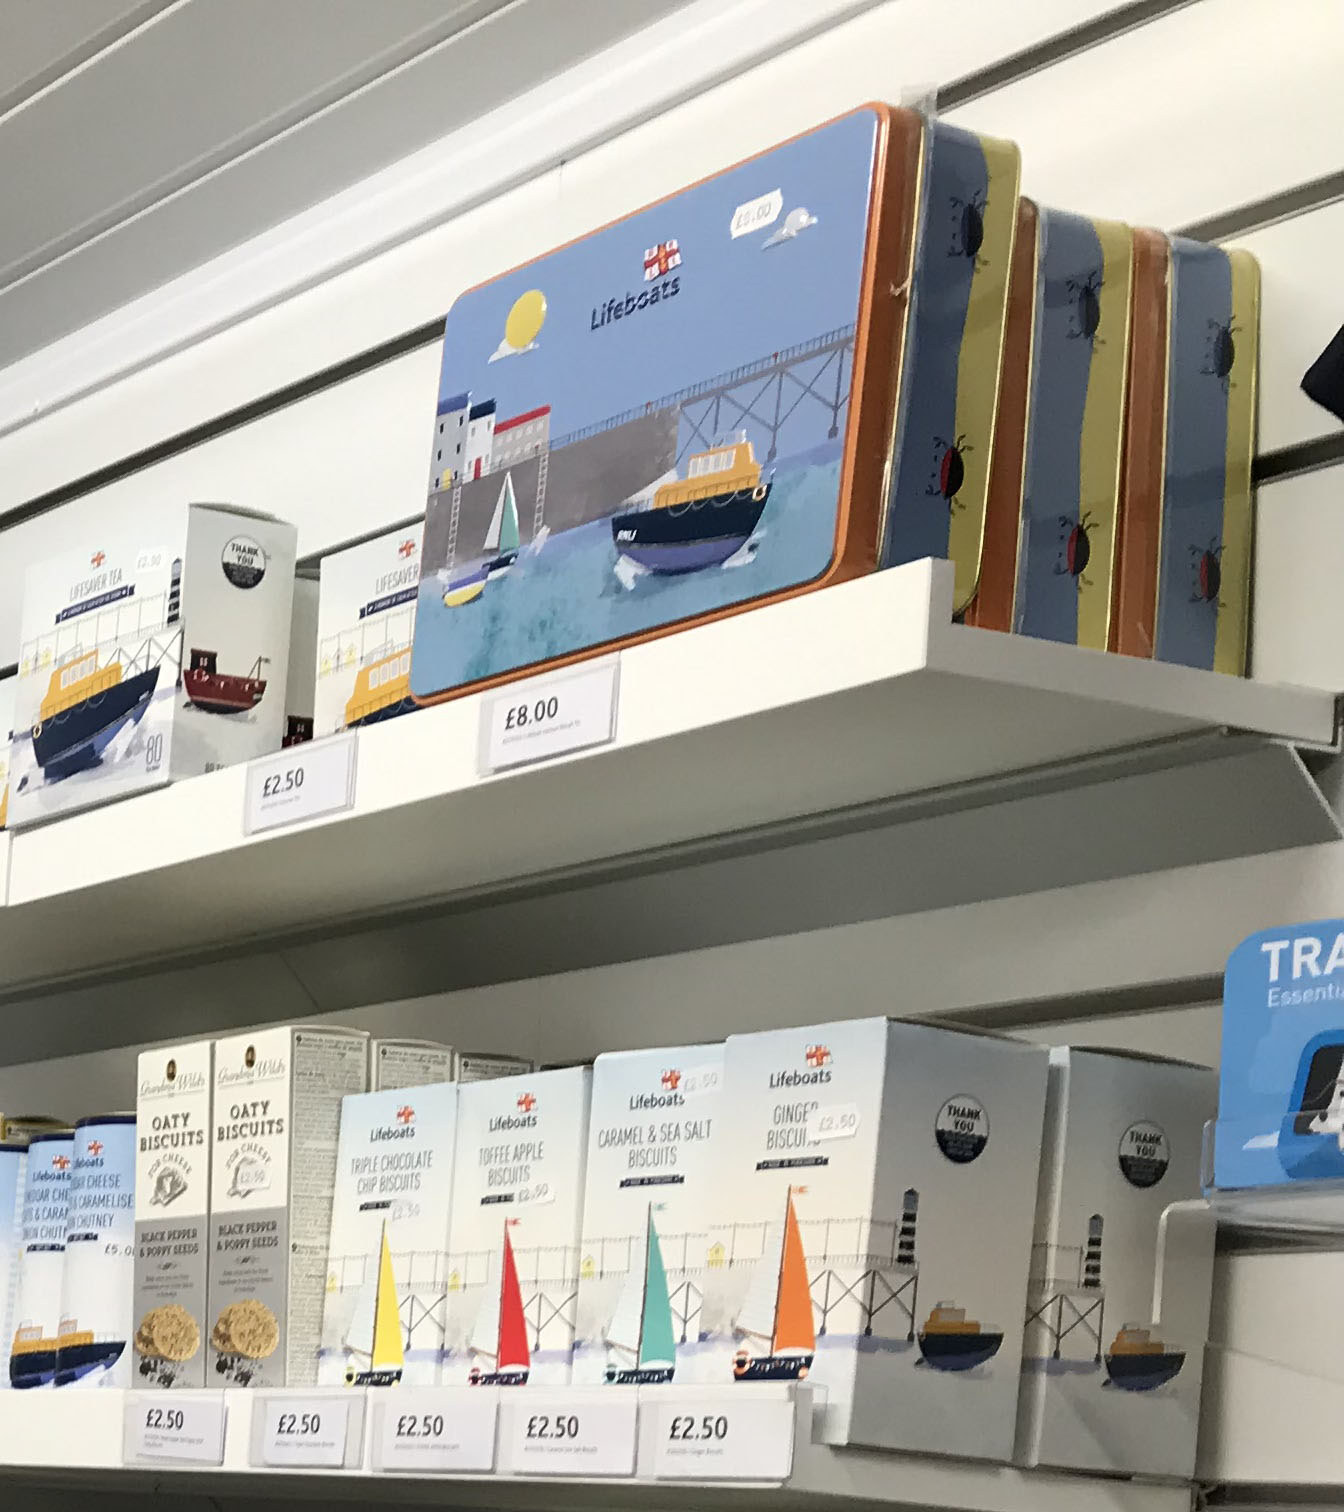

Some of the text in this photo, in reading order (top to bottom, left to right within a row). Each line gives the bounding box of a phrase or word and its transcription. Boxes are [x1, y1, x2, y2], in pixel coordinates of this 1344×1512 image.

[591, 275, 682, 333] Lifeboats
[504, 697, 559, 730] £8.00
[145, 731, 163, 763] 80
[262, 768, 304, 797] £2.50
[769, 1068, 831, 1088] Lifeboats
[230, 1101, 269, 1119] OATY
[629, 1092, 685, 1109] Lifeboats
[152, 1113, 189, 1131] OATY
[489, 1114, 538, 1131] Lifeboats
[819, 1114, 856, 1131] £2.50
[946, 1103, 981, 1121] THANK
[217, 1119, 284, 1141] BISCUITS
[370, 1125, 415, 1141] Lifeboats
[598, 1127, 644, 1148] CARAMEL
[660, 1123, 681, 1141] SEA
[684, 1119, 712, 1140] SALT
[954, 1118, 974, 1133] YOU
[140, 1130, 204, 1151] BISCUITS
[351, 1151, 433, 1175] TRIPLE CHOCOLATE
[479, 1141, 544, 1166] TOFFEE APPLE
[628, 1146, 677, 1168] BISCUITS
[379, 1171, 421, 1191] BISCUITS
[488, 1165, 530, 1186] BISCUITS
[146, 1409, 183, 1429] £2.50
[278, 1413, 320, 1434] £2.50
[397, 1415, 443, 1437] £2.50
[527, 1416, 578, 1438] £2.50
[670, 1416, 728, 1439] £2.50
